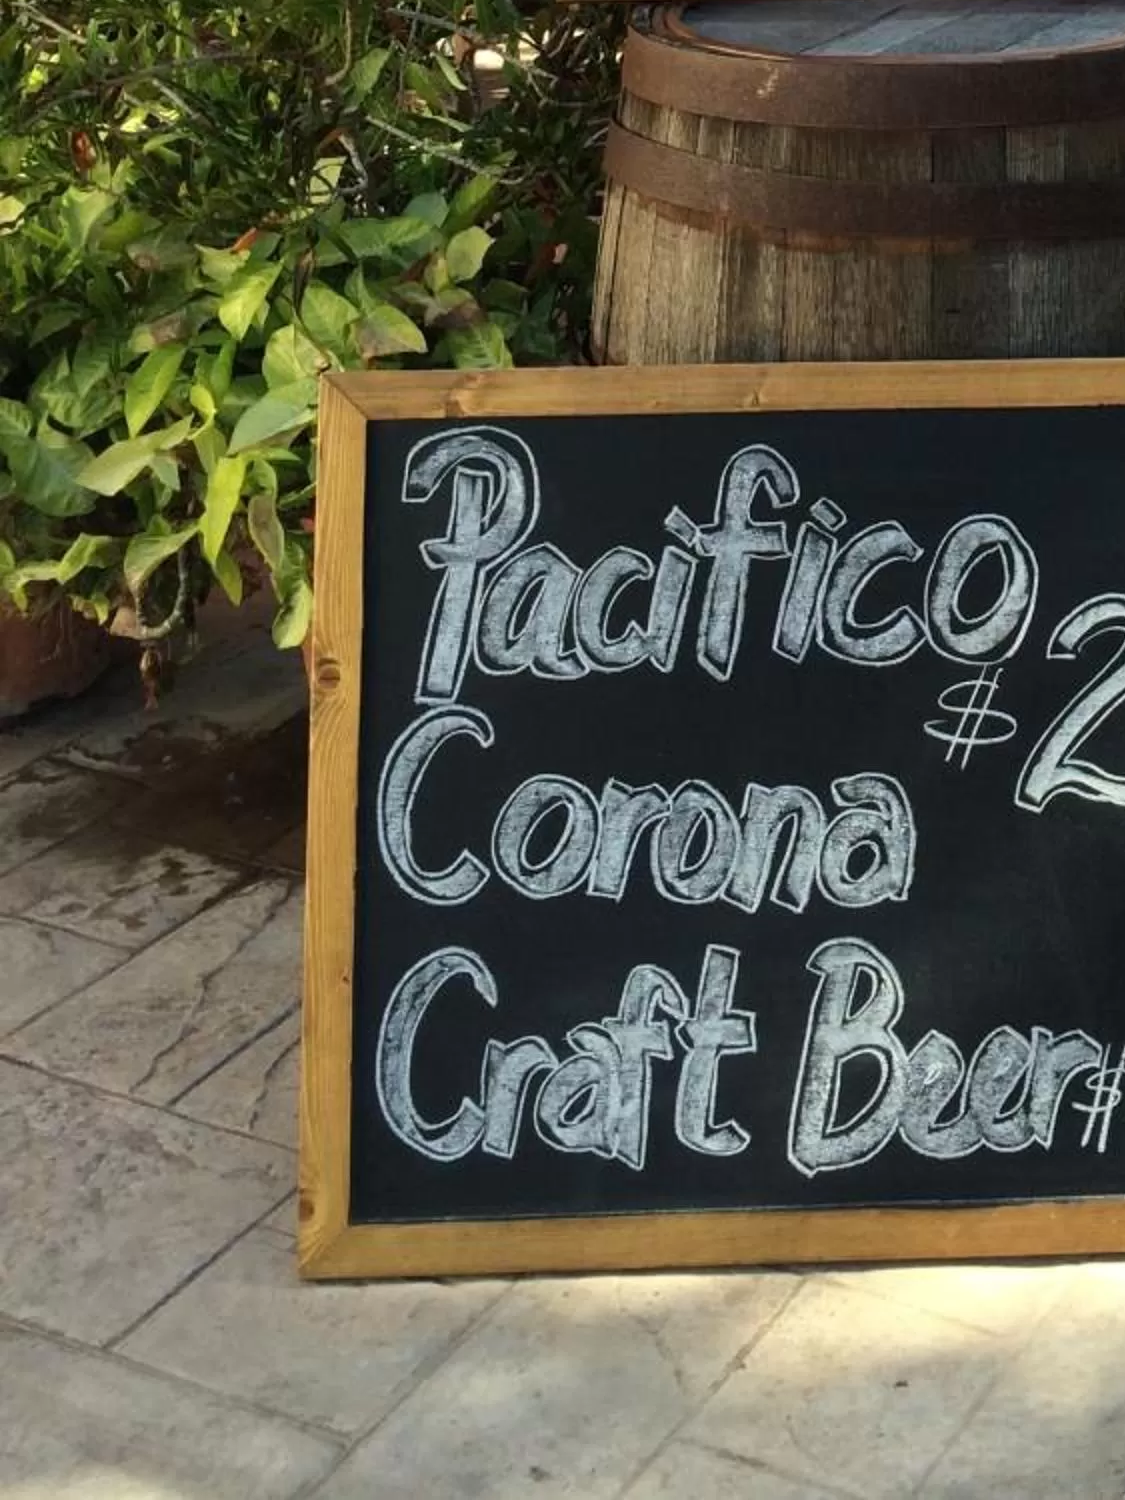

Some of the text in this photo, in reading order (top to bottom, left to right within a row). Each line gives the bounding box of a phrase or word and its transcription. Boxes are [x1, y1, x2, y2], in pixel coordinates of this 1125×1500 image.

[376, 704, 917, 914] Corona
[375, 943, 758, 1171] Craft
[786, 936, 1104, 1179] Beer
